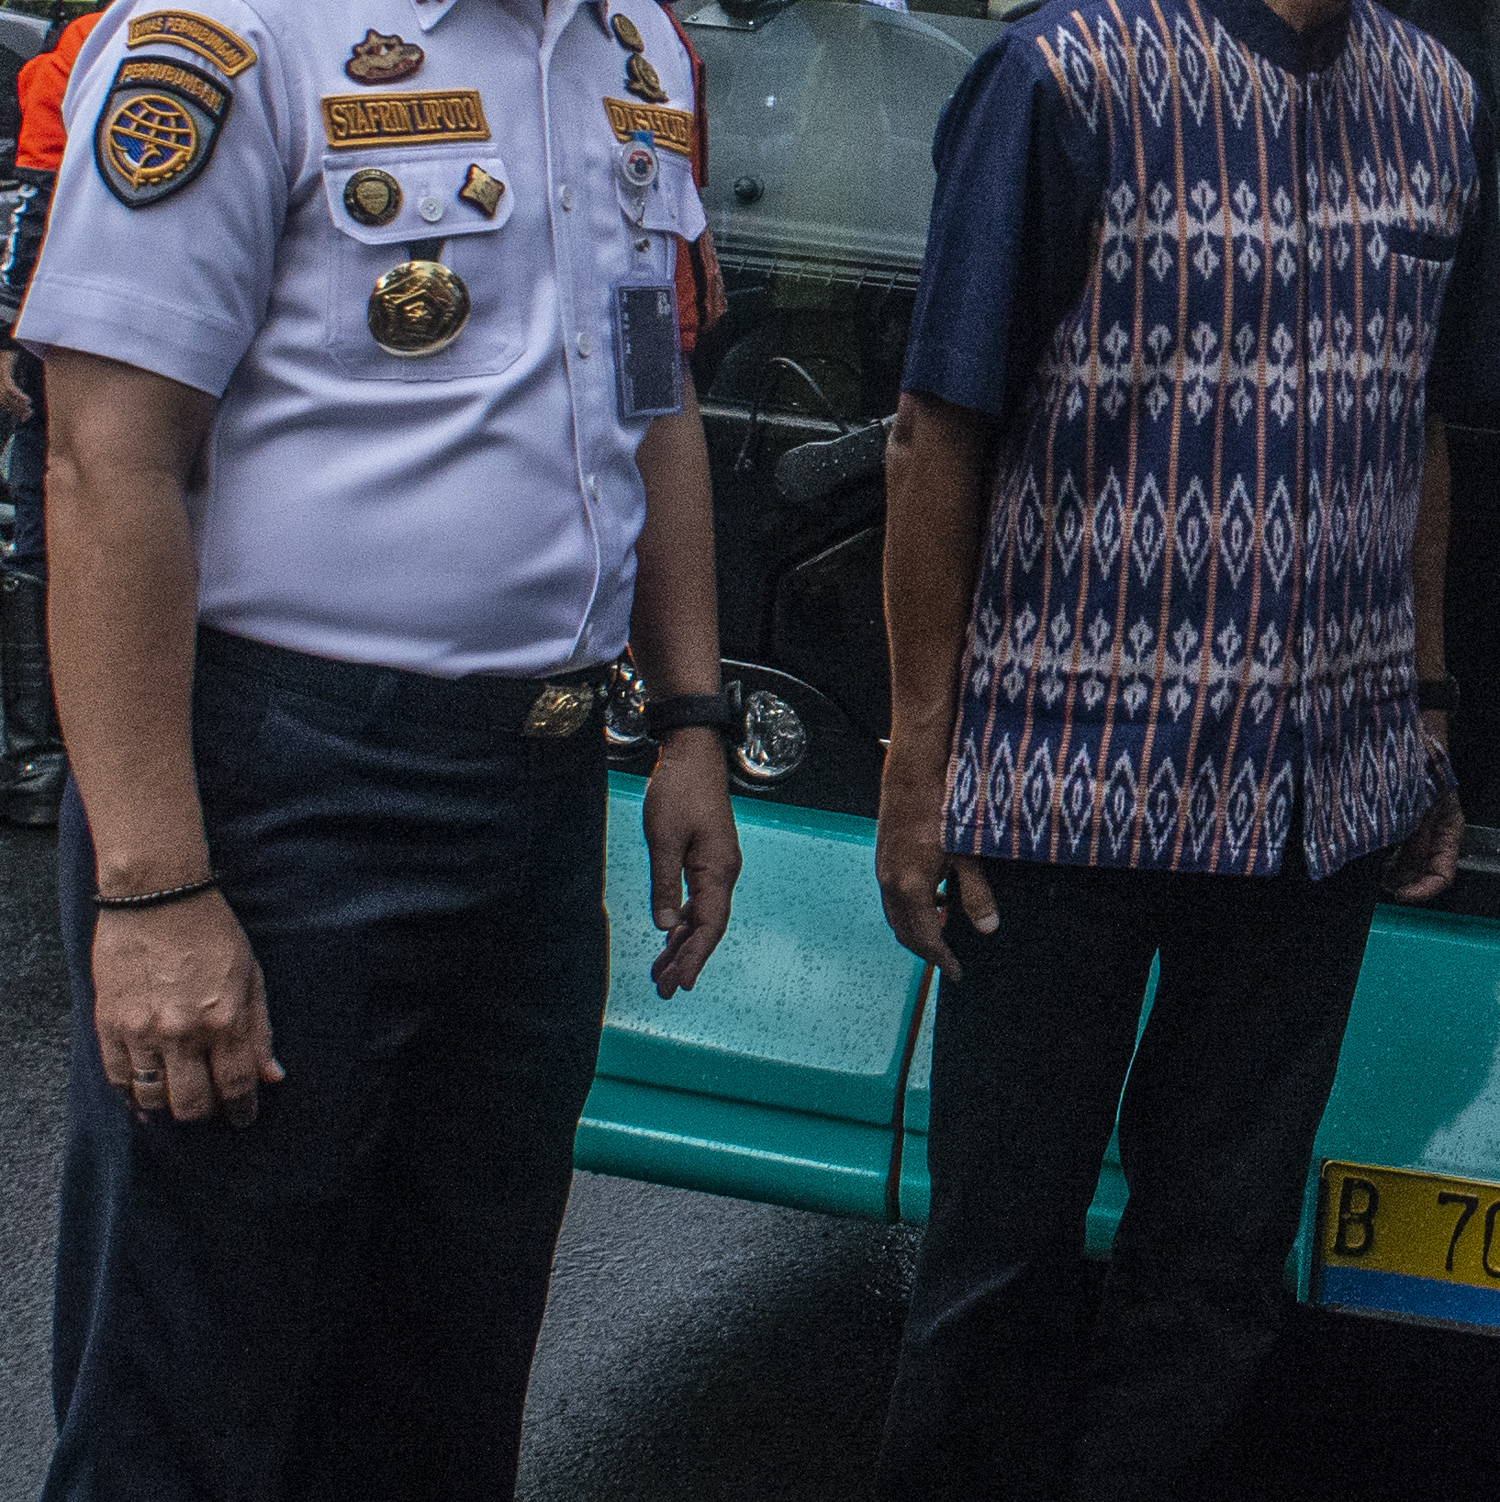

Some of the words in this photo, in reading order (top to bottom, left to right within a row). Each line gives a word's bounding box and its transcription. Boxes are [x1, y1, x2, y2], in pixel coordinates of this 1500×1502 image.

[330, 101, 414, 137] SYAFRIN
[411, 98, 479, 130] LIPUTO
[1333, 1176, 1380, 1258] B
